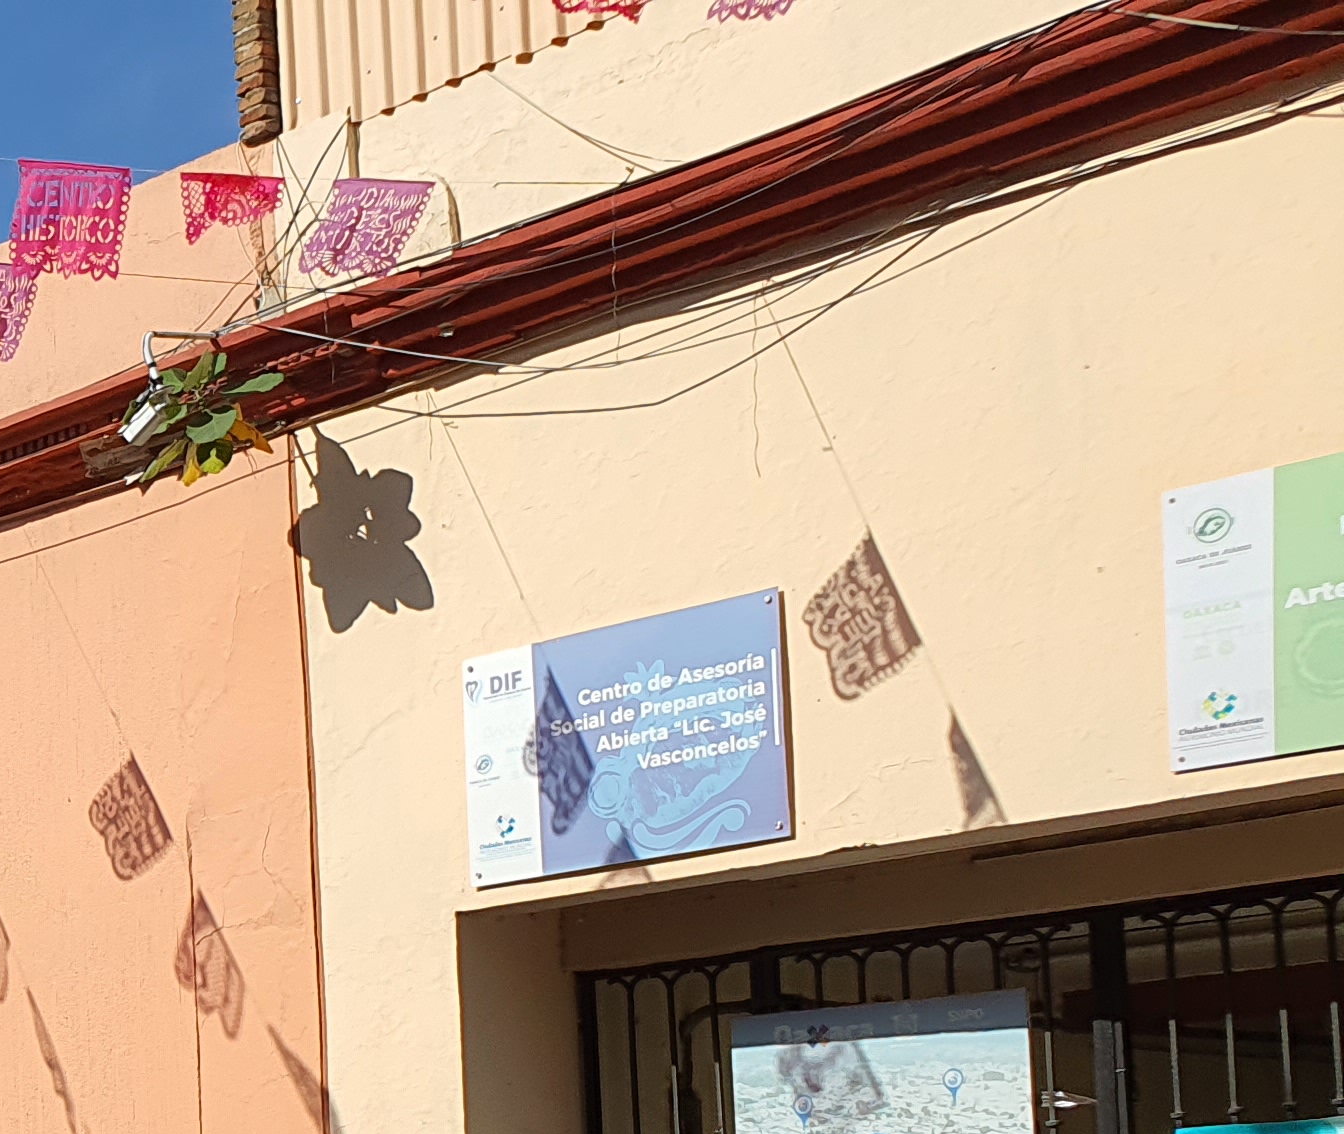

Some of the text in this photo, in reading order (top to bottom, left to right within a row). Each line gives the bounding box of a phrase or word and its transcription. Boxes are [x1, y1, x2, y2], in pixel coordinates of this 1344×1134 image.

[28, 180, 114, 210] CENTRO
[489, 670, 524, 696] DIF
[577, 653, 766, 707] Centro de Asesoría
[550, 679, 767, 737] Social de Preparatoria
[596, 726, 669, 753] Abierta
[720, 703, 768, 729] José
[636, 731, 769, 770] Vasconcelos”
